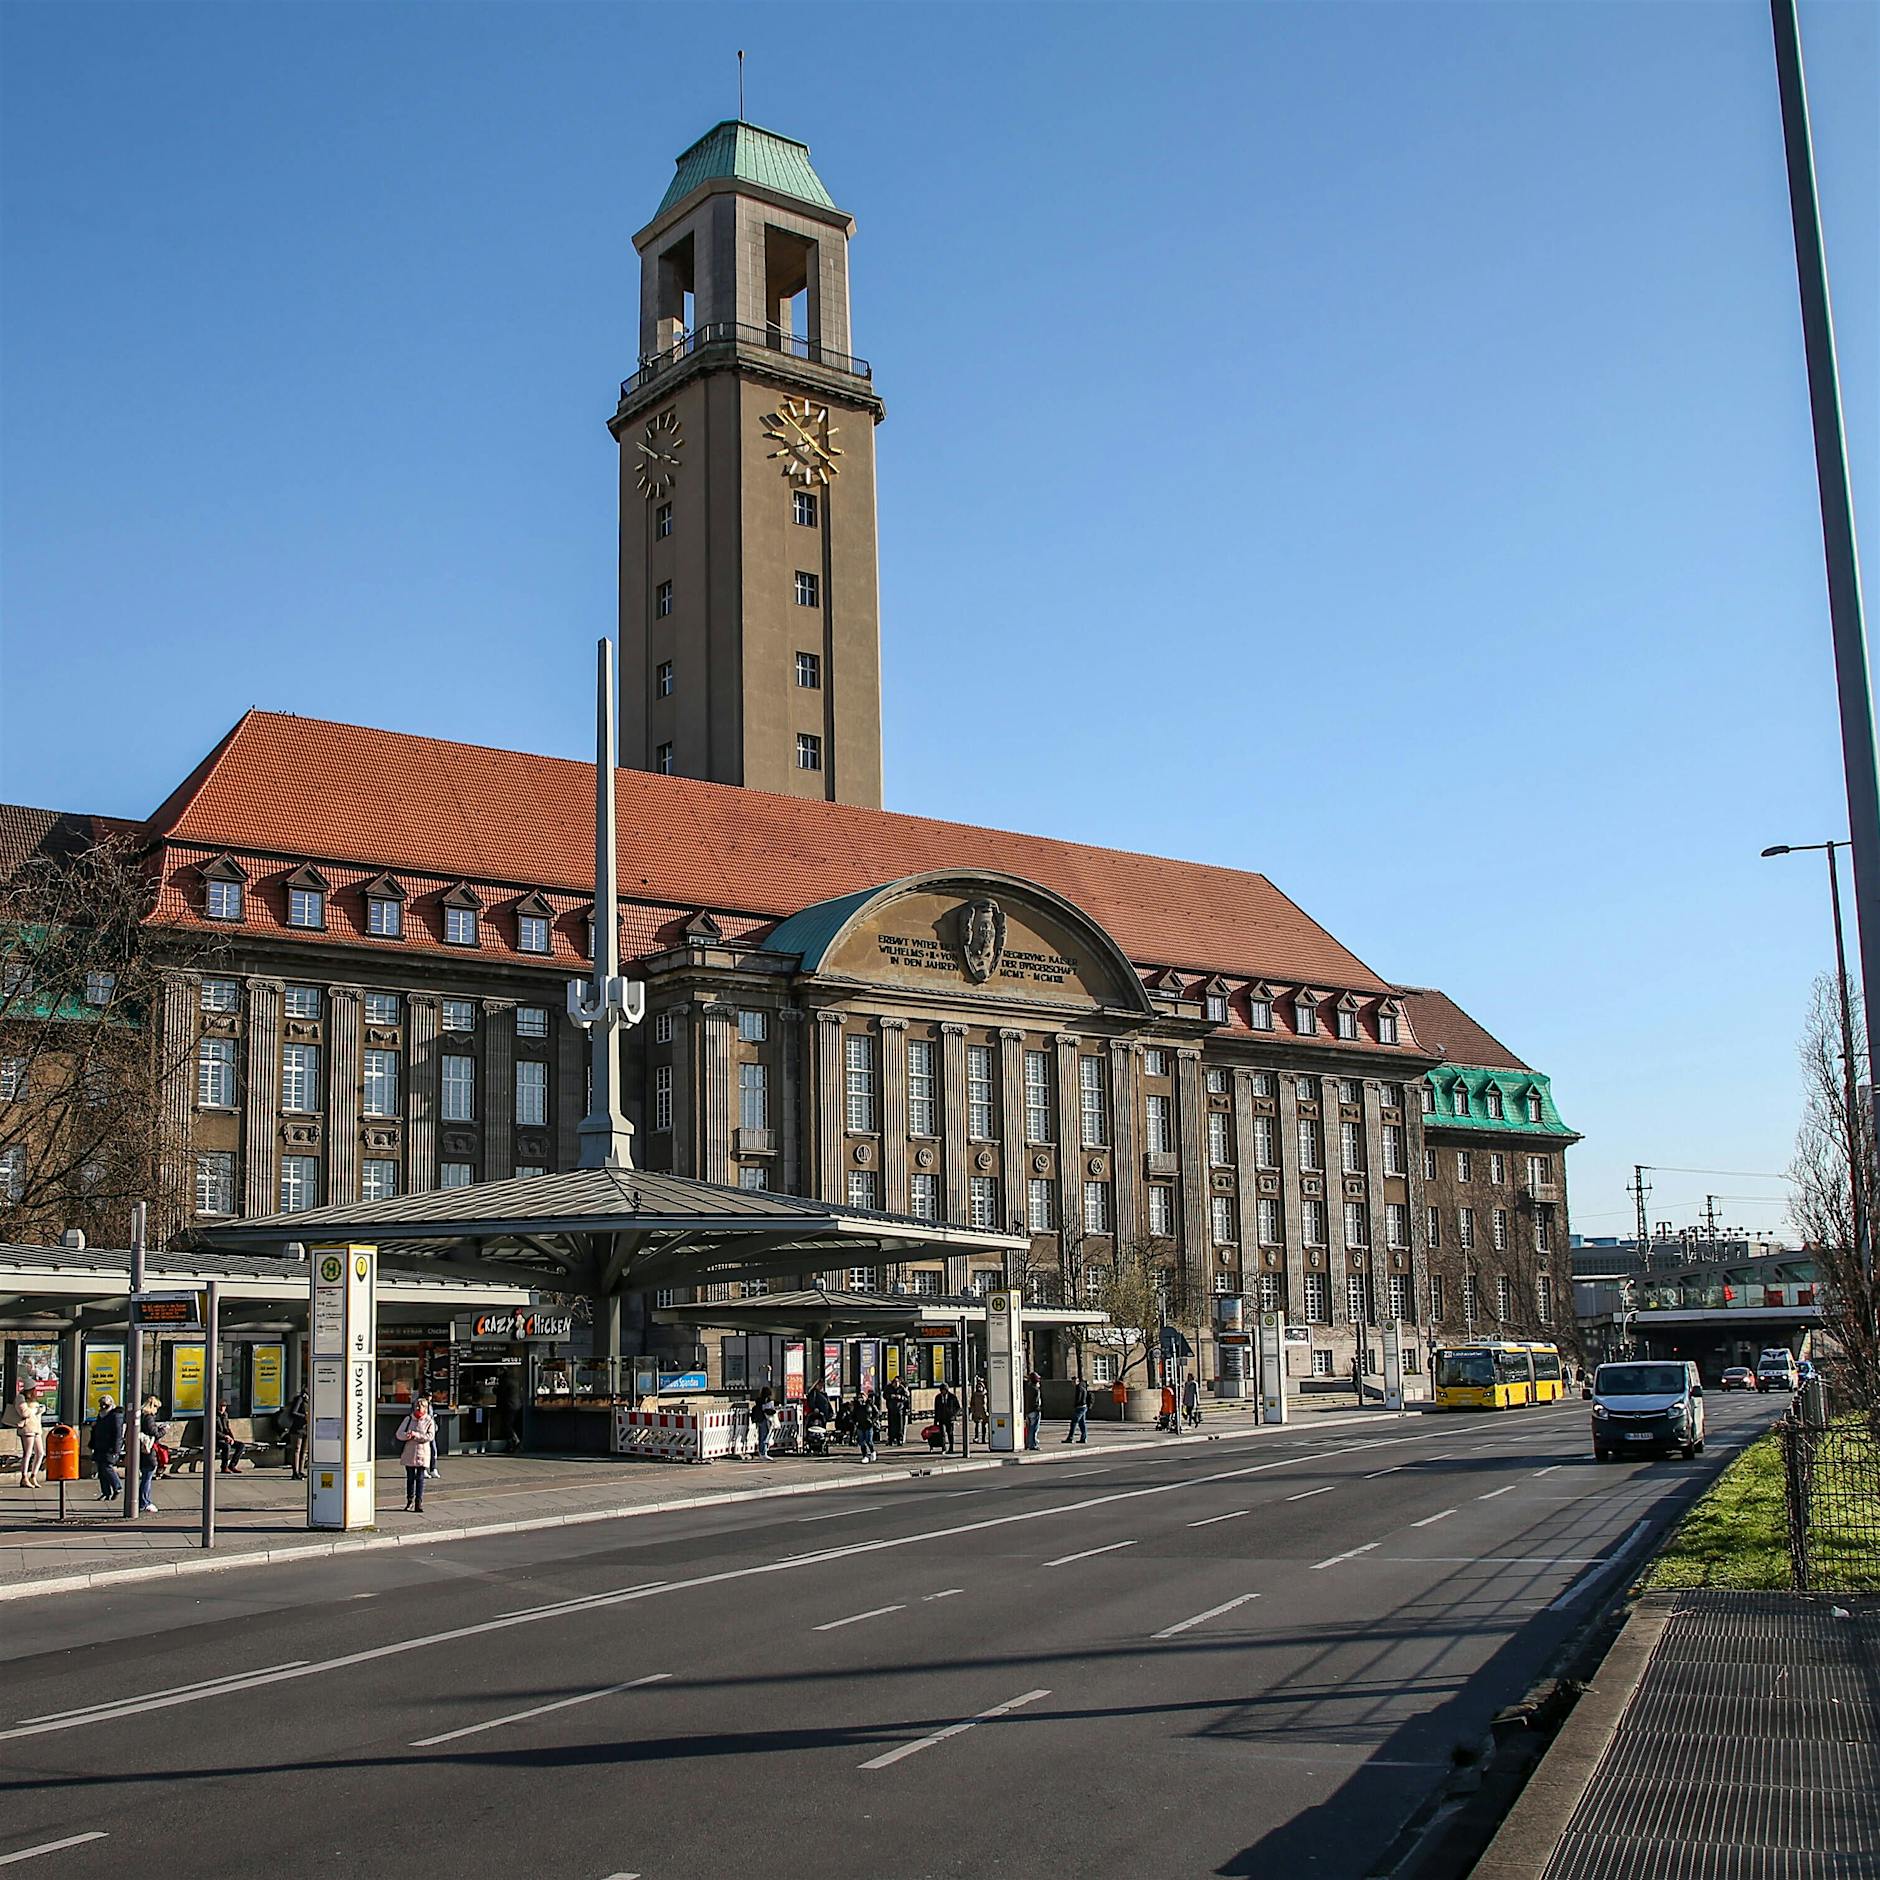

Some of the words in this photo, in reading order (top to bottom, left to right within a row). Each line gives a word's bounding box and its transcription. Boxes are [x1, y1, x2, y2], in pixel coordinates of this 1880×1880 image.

[878, 934, 909, 946] ERBAVT
[912, 939, 938, 949] VNTER
[1003, 950, 1045, 962] REGIERVNG
[1049, 956, 1078, 966] KAISER
[879, 945, 924, 958] WILHELMS
[1002, 960, 1017, 968] DER
[904, 958, 922, 967] DEN
[925, 960, 959, 971] JAHREN
[477, 1315, 514, 1335] CRAZY
